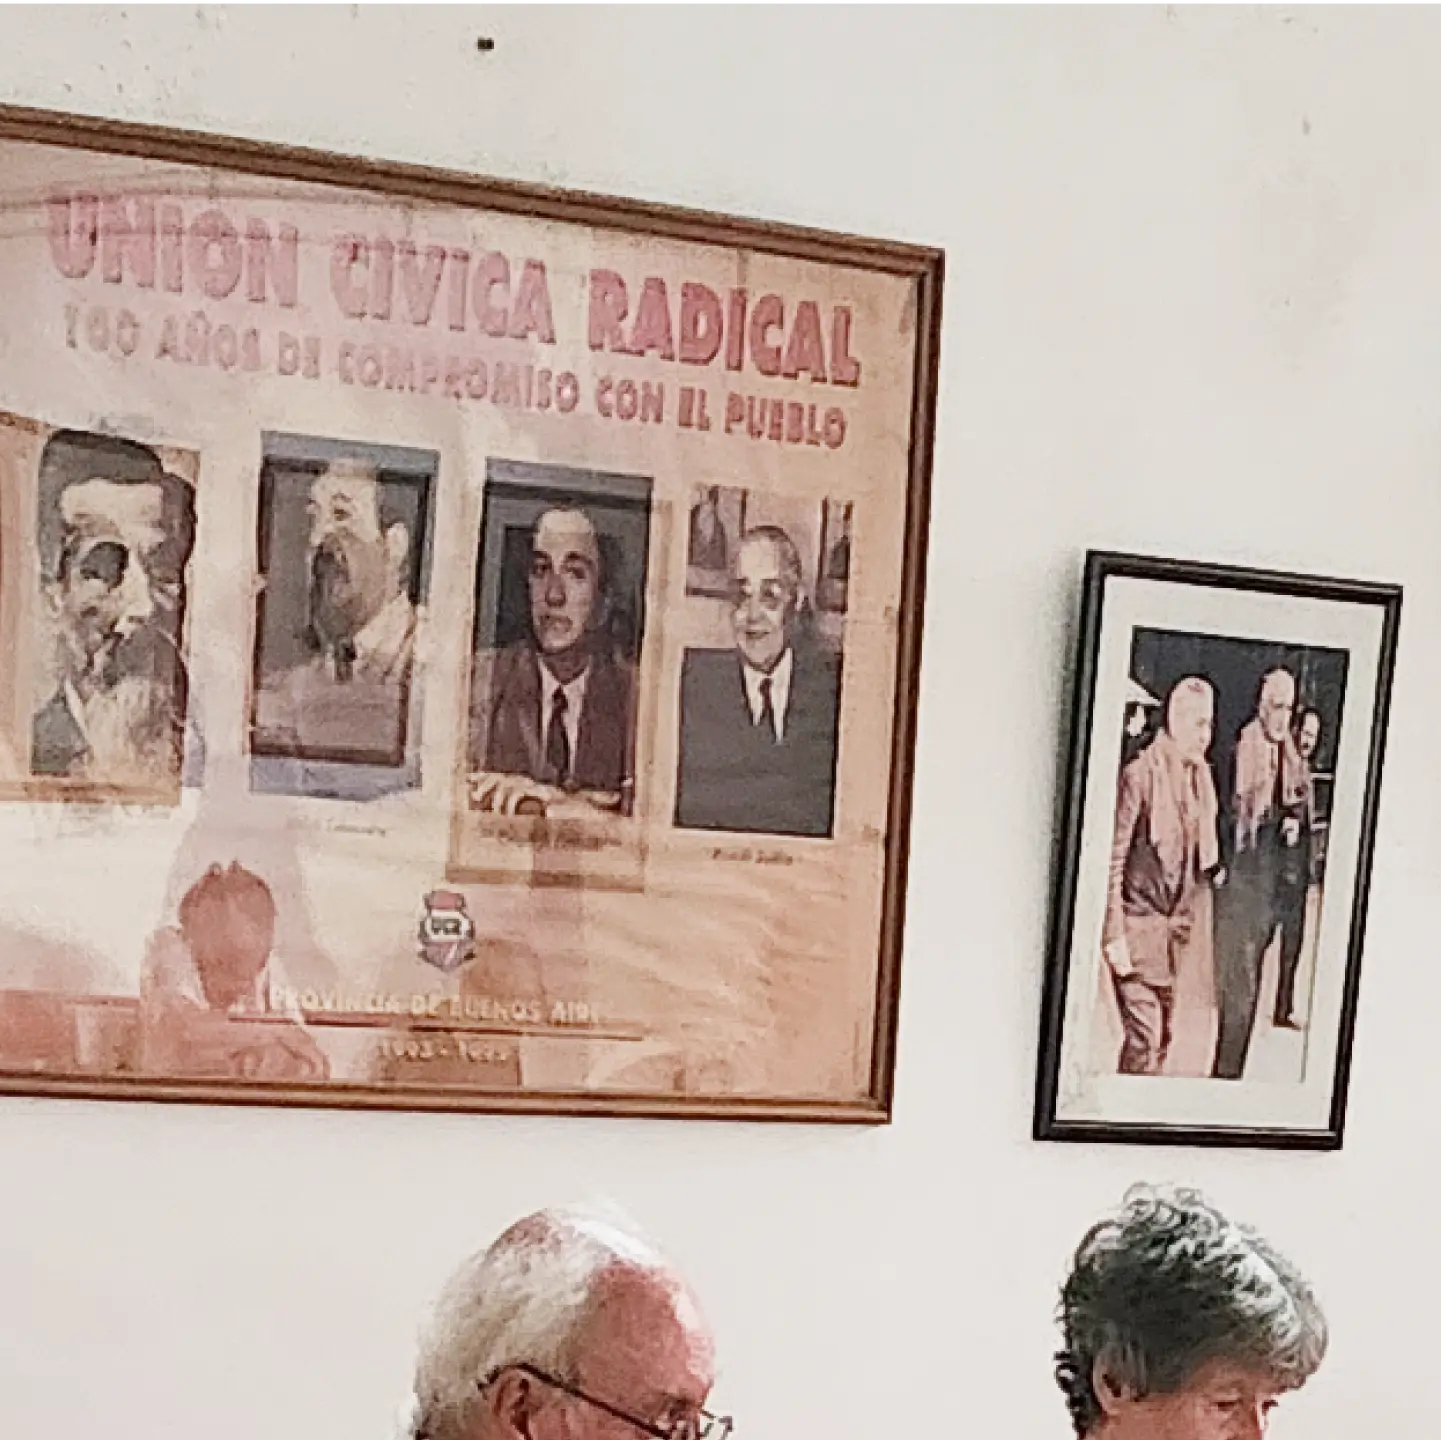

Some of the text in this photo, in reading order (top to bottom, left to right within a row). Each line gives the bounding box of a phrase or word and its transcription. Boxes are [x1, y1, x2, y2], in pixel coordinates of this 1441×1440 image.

[47, 192, 860, 388] UNION CIVICA RADICAL
[277, 330, 321, 380] DE
[338, 340, 579, 413] COMPROMISO
[596, 375, 664, 424] CON
[677, 386, 711, 431] EL
[724, 391, 847, 449] PUEBLO
